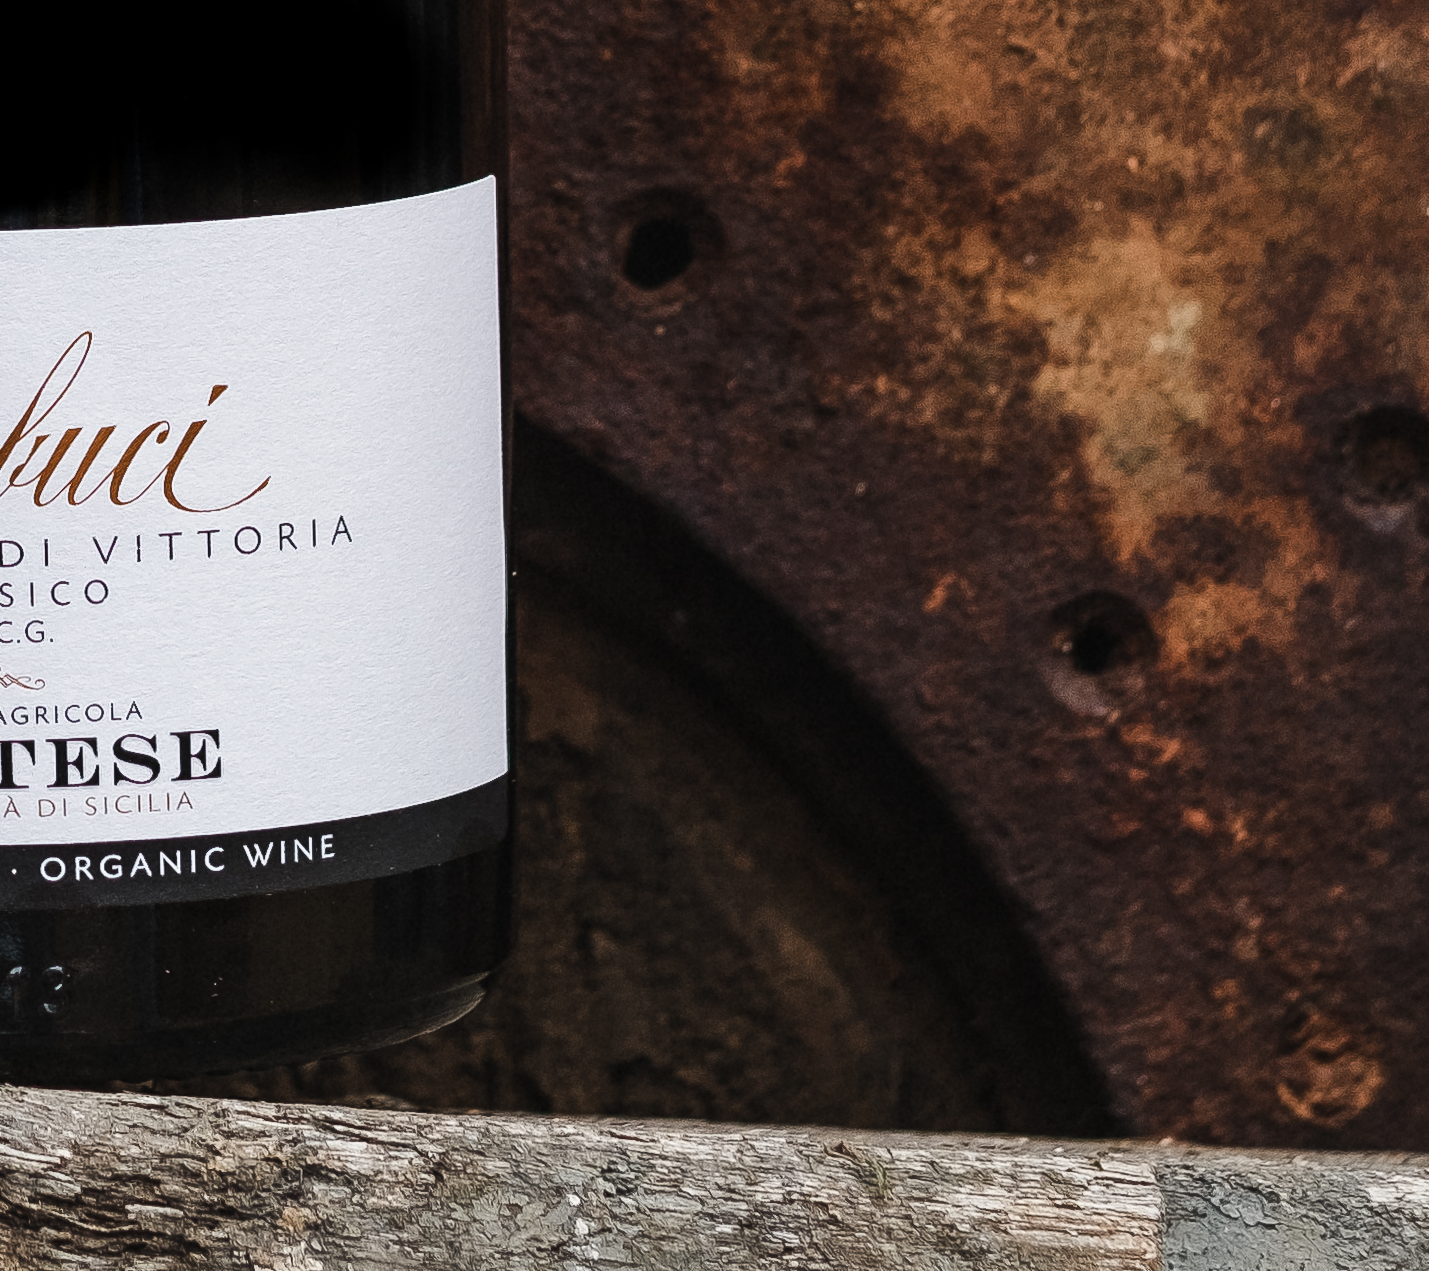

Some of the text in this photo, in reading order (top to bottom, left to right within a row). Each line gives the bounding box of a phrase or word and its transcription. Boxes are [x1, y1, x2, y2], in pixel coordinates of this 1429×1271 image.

[91, 514, 354, 565] VITTORIA
[37, 797, 68, 818] DI
[84, 790, 194, 817] SICILIA
[39, 849, 226, 882] ORGANIC
[242, 833, 336, 869] WINE
